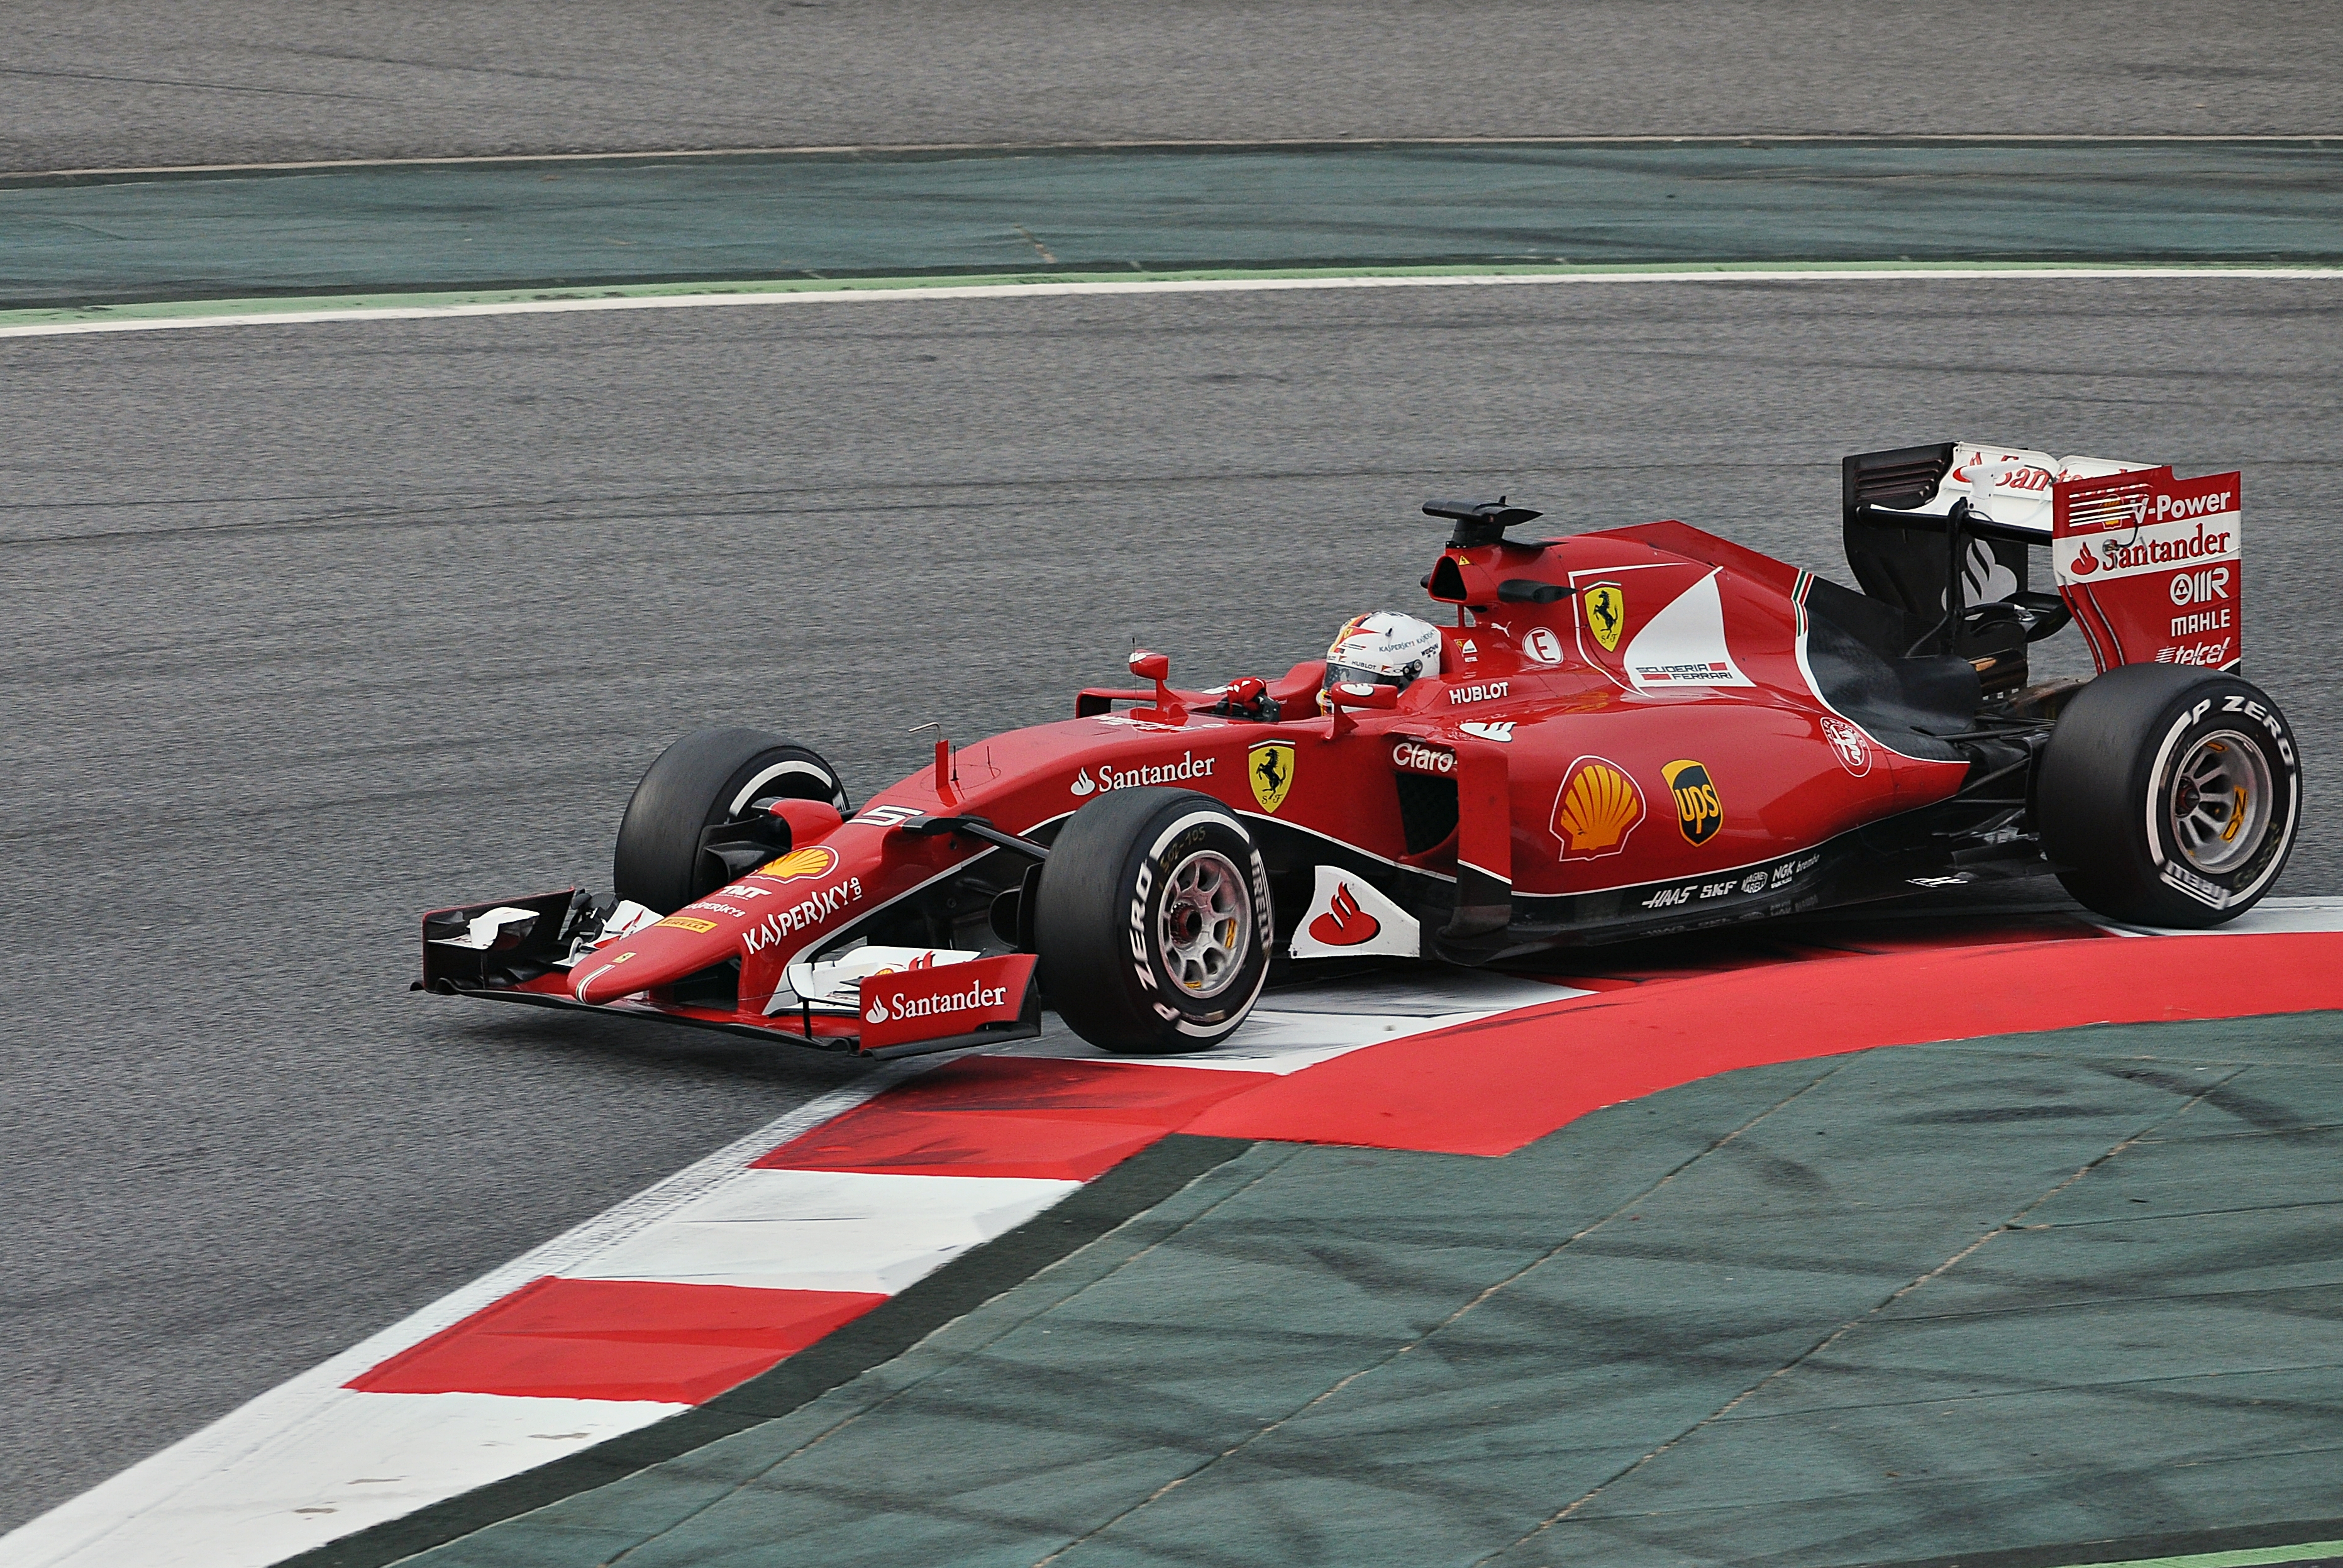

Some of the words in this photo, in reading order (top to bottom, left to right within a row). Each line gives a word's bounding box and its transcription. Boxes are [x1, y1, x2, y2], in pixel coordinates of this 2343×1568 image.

[2102, 522, 2230, 571] Santander
[2171, 609, 2230, 637] MAHLE
[1532, 632, 1557, 661] E
[2174, 636, 2231, 666] telcel
[1351, 661, 1376, 670] HUBLOT
[1636, 664, 1709, 673] SCUDERIA
[1449, 682, 1509, 705] HUBLOT
[2192, 698, 2212, 726] P
[2221, 695, 2295, 767] ZERO
[1099, 750, 1216, 793] Santander
[1393, 743, 1454, 773] Claro
[845, 804, 926, 827] 5
[1772, 861, 1795, 881] NGK
[718, 885, 773, 898] TNT
[1642, 885, 1698, 908] HAAS
[1700, 881, 1737, 898] SKF
[742, 881, 848, 954] KASPERSKY
[1129, 858, 1159, 992] ZERO
[892, 979, 1007, 1020] Santander
